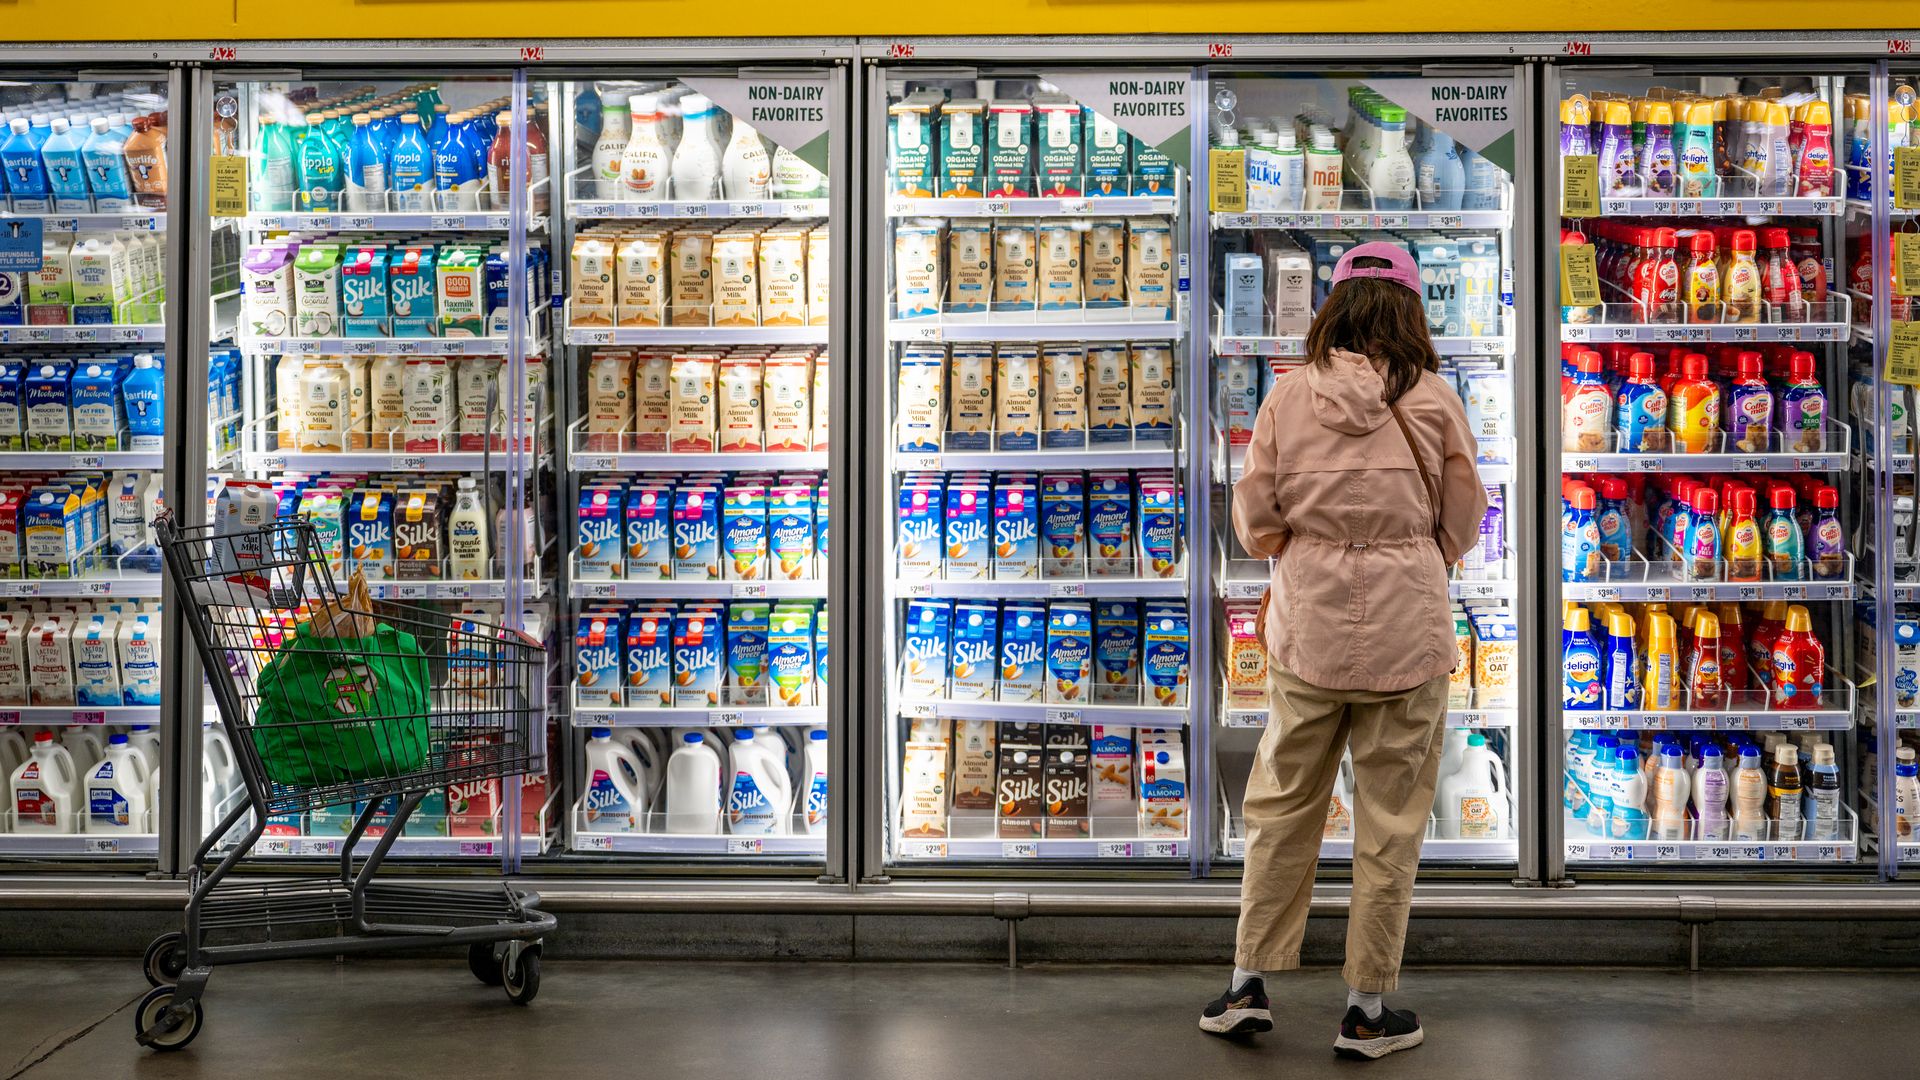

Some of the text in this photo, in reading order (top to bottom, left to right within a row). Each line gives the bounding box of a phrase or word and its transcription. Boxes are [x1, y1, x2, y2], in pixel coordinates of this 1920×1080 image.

[892, 45, 914, 57] A25
[1209, 44, 1232, 57] A26
[1567, 43, 1590, 54] A27
[1888, 41, 1910, 52] A28
[213, 48, 236, 60] A23
[521, 48, 543, 60] A24
[749, 86, 823, 100] NON-DAIRY
[1110, 82, 1185, 95] NON-DAIRY
[1432, 86, 1508, 100] NON-DAIRY
[752, 107, 823, 122] FAVORITES
[1114, 103, 1185, 116] FAVORITES
[1436, 107, 1508, 122] FAVORITES
[1682, 154, 1708, 164] delight
[1808, 152, 1830, 160] delight
[447, 278, 469, 286] GOOD
[344, 277, 386, 304] Silk
[392, 277, 432, 304] Silk
[1428, 285, 1455, 300] LY!
[444, 299, 474, 308] flaxmilk
[29, 388, 64, 398] Mootopia
[75, 388, 110, 398] Mootopia
[1579, 402, 1604, 413] Coffee
[1744, 402, 1770, 412] Coffee
[1093, 511, 1127, 523] Almond
[1099, 519, 1122, 528] Breeze
[350, 521, 390, 547] Silk
[627, 520, 668, 545] Silk
[676, 520, 717, 545] Silk
[773, 524, 808, 538] Almond
[901, 518, 940, 544] Silk
[996, 518, 1037, 545] Silk
[452, 538, 481, 547] Organic
[907, 637, 945, 662] Silk
[954, 640, 994, 665] Silk
[1002, 641, 1043, 667] Silk
[577, 647, 618, 674] Silk
[628, 647, 668, 673] Silk
[1149, 652, 1184, 664] Almond
[1240, 660, 1258, 669] OAT
[1155, 660, 1179, 670] Breeze
[1564, 661, 1598, 672] delight
[1001, 778, 1040, 804] Silk
[1047, 778, 1087, 804] Silk
[587, 789, 621, 810] Silk
[731, 791, 764, 810] Silk
